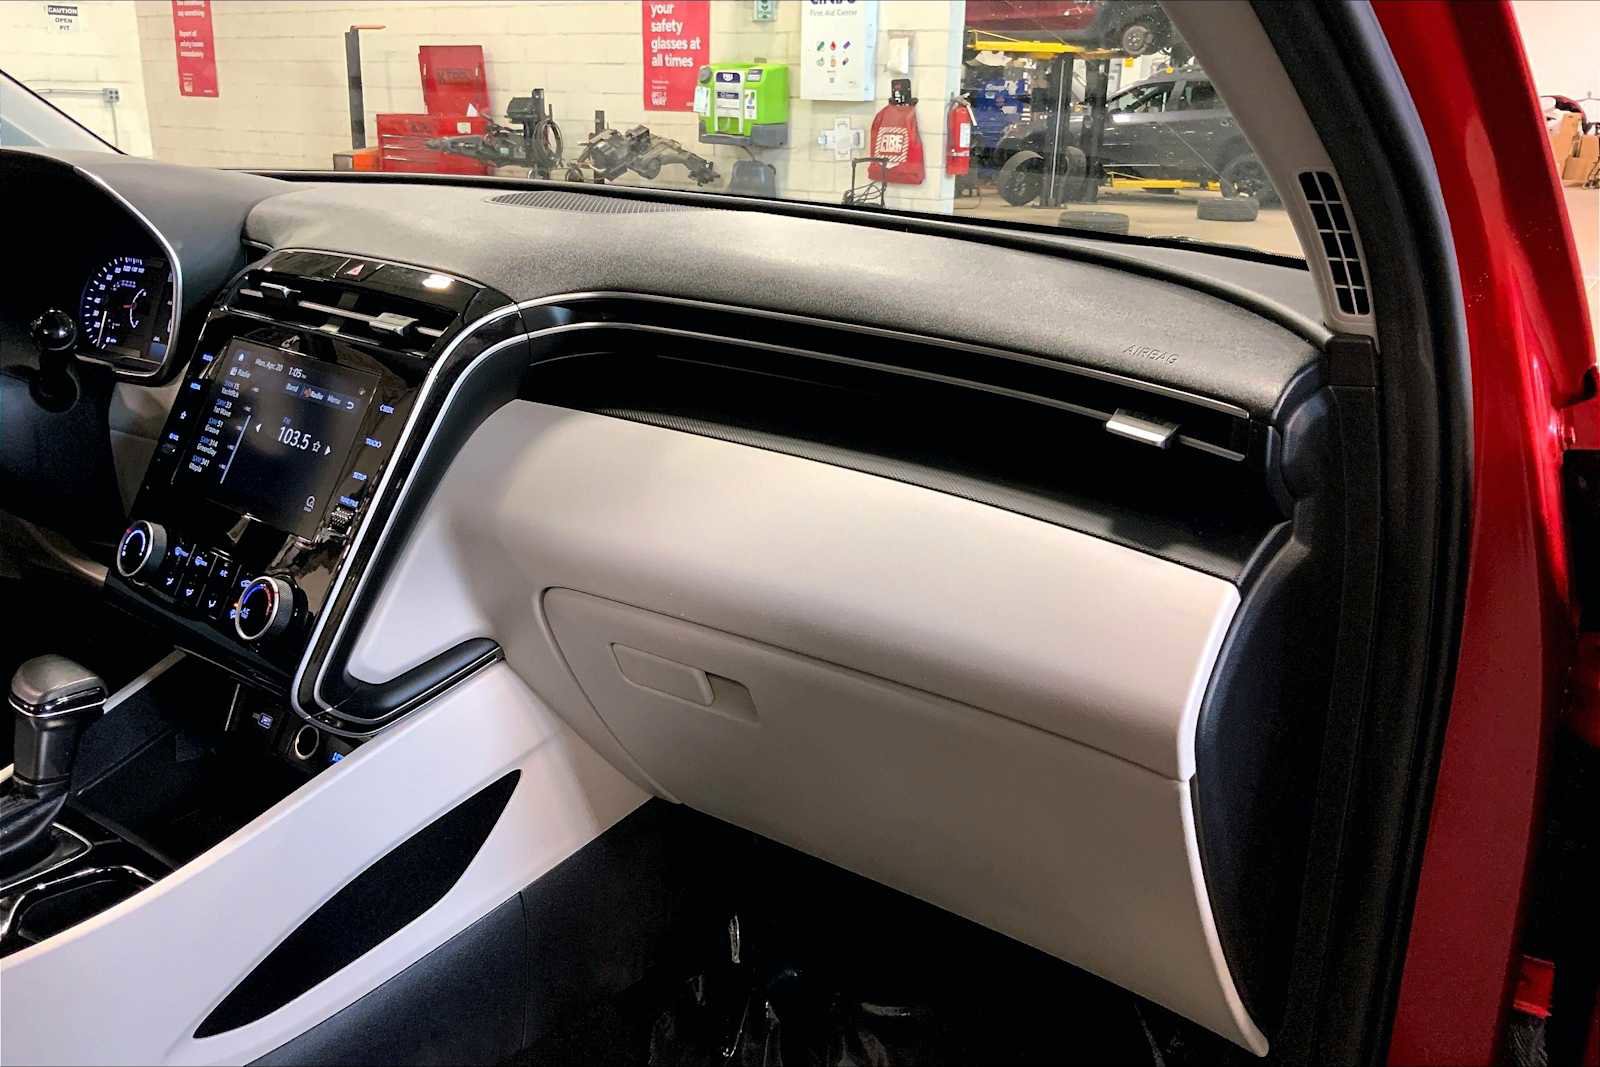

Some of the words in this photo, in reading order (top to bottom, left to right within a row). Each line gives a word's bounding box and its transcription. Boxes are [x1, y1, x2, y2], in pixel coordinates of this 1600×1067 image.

[48, 6, 77, 15] CAUTION
[650, 3, 674, 18] your
[651, 18, 683, 35] safety
[651, 36, 688, 53] glasses
[689, 37, 701, 50] at
[651, 53, 664, 67] all
[664, 54, 694, 68] times
[882, 134, 904, 145] FIRE
[1123, 344, 1180, 366] AIRBAG
[288, 367, 303, 378] 1:05
[278, 426, 311, 450] 103.5
